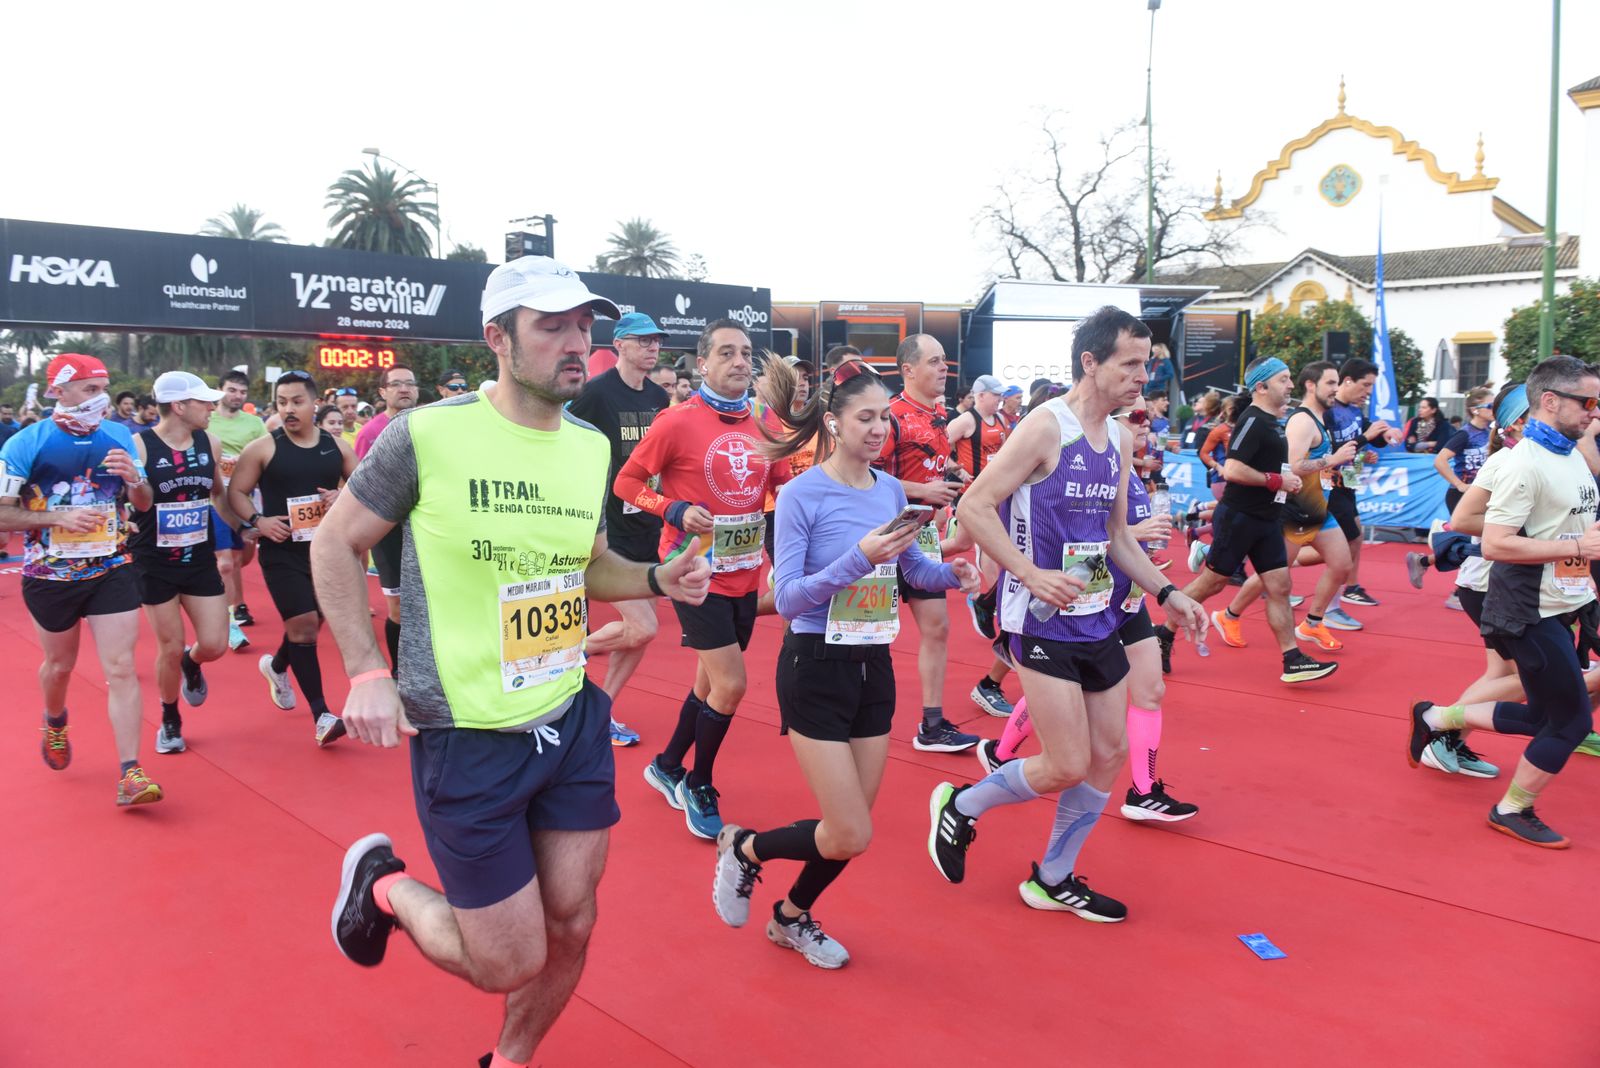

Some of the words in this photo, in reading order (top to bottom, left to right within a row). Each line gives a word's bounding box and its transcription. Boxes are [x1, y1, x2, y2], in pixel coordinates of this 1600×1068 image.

[9, 254, 117, 288] HOKA
[322, 274, 425, 298] maratón
[170, 301, 211, 310] Healthcare
[212, 303, 240, 311] Partner
[350, 294, 427, 315] sevilla
[337, 316, 351, 327] 28
[353, 319, 383, 328] enero
[384, 319, 410, 329] 2024
[621, 426, 639, 440] RUN
[492, 480, 544, 501] TRAIL
[1065, 481, 1085, 498] EL
[166, 511, 200, 528] 2062
[494, 503, 524, 514] SENDA
[526, 504, 563, 516] COSTERA
[565, 508, 594, 520] NAVIEGA
[1135, 504, 1151, 518] EL
[724, 526, 759, 547] 7637
[471, 539, 492, 561] 30
[493, 553, 507, 561] 2017
[498, 560, 508, 571] 21
[510, 560, 515, 571] K
[507, 584, 524, 597] MEDIO
[526, 579, 551, 592] MARATÓN
[845, 583, 887, 608] 7261
[510, 597, 582, 640] 10339
